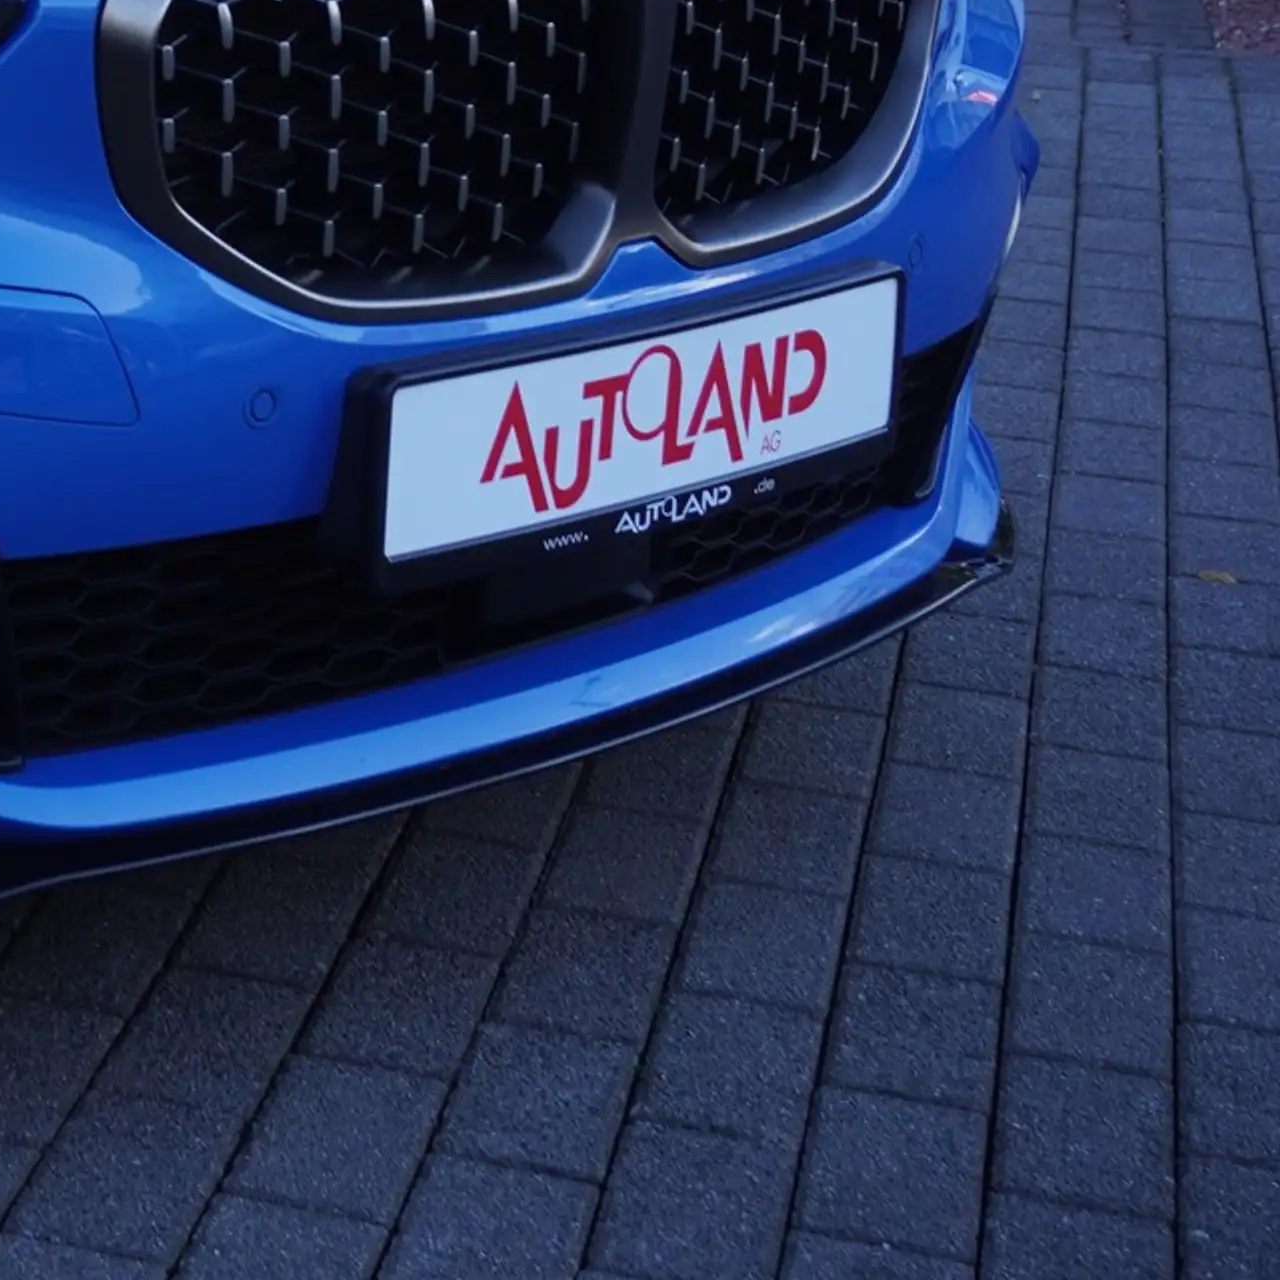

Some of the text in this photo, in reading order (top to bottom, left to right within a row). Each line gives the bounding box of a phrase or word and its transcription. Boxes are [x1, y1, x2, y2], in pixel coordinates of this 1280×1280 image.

[759, 429, 782, 456] AG
[543, 531, 589, 552] www.
[754, 477, 776, 495] .de
